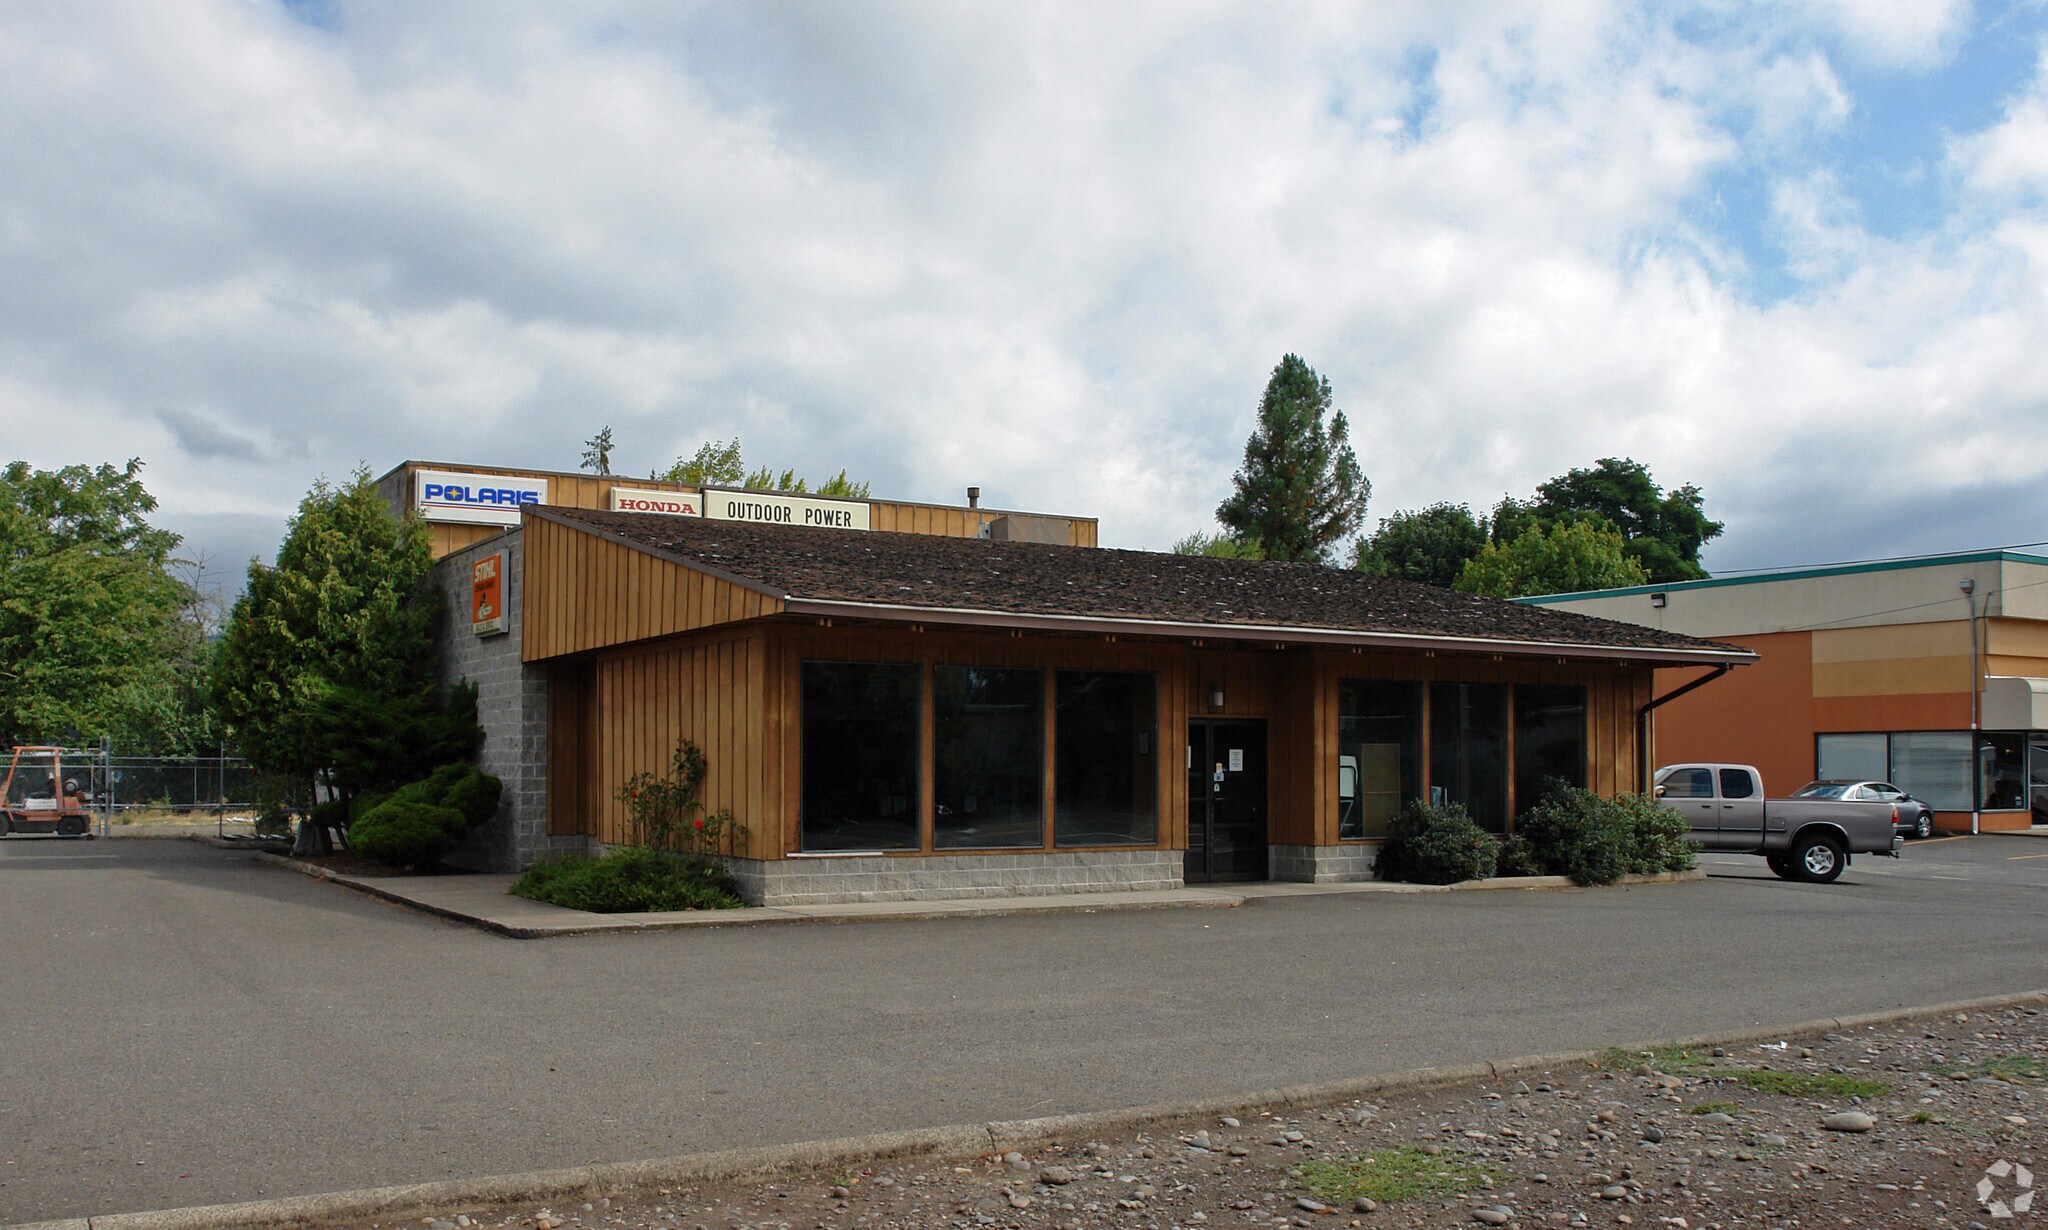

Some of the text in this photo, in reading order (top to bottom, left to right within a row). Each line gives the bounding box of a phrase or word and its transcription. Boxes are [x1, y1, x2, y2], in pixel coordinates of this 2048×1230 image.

[425, 483, 539, 505] POLARIS
[619, 498, 697, 515] HONDA
[727, 501, 852, 527] OUTDOOR POWER
[474, 559, 496, 583] STIHL
